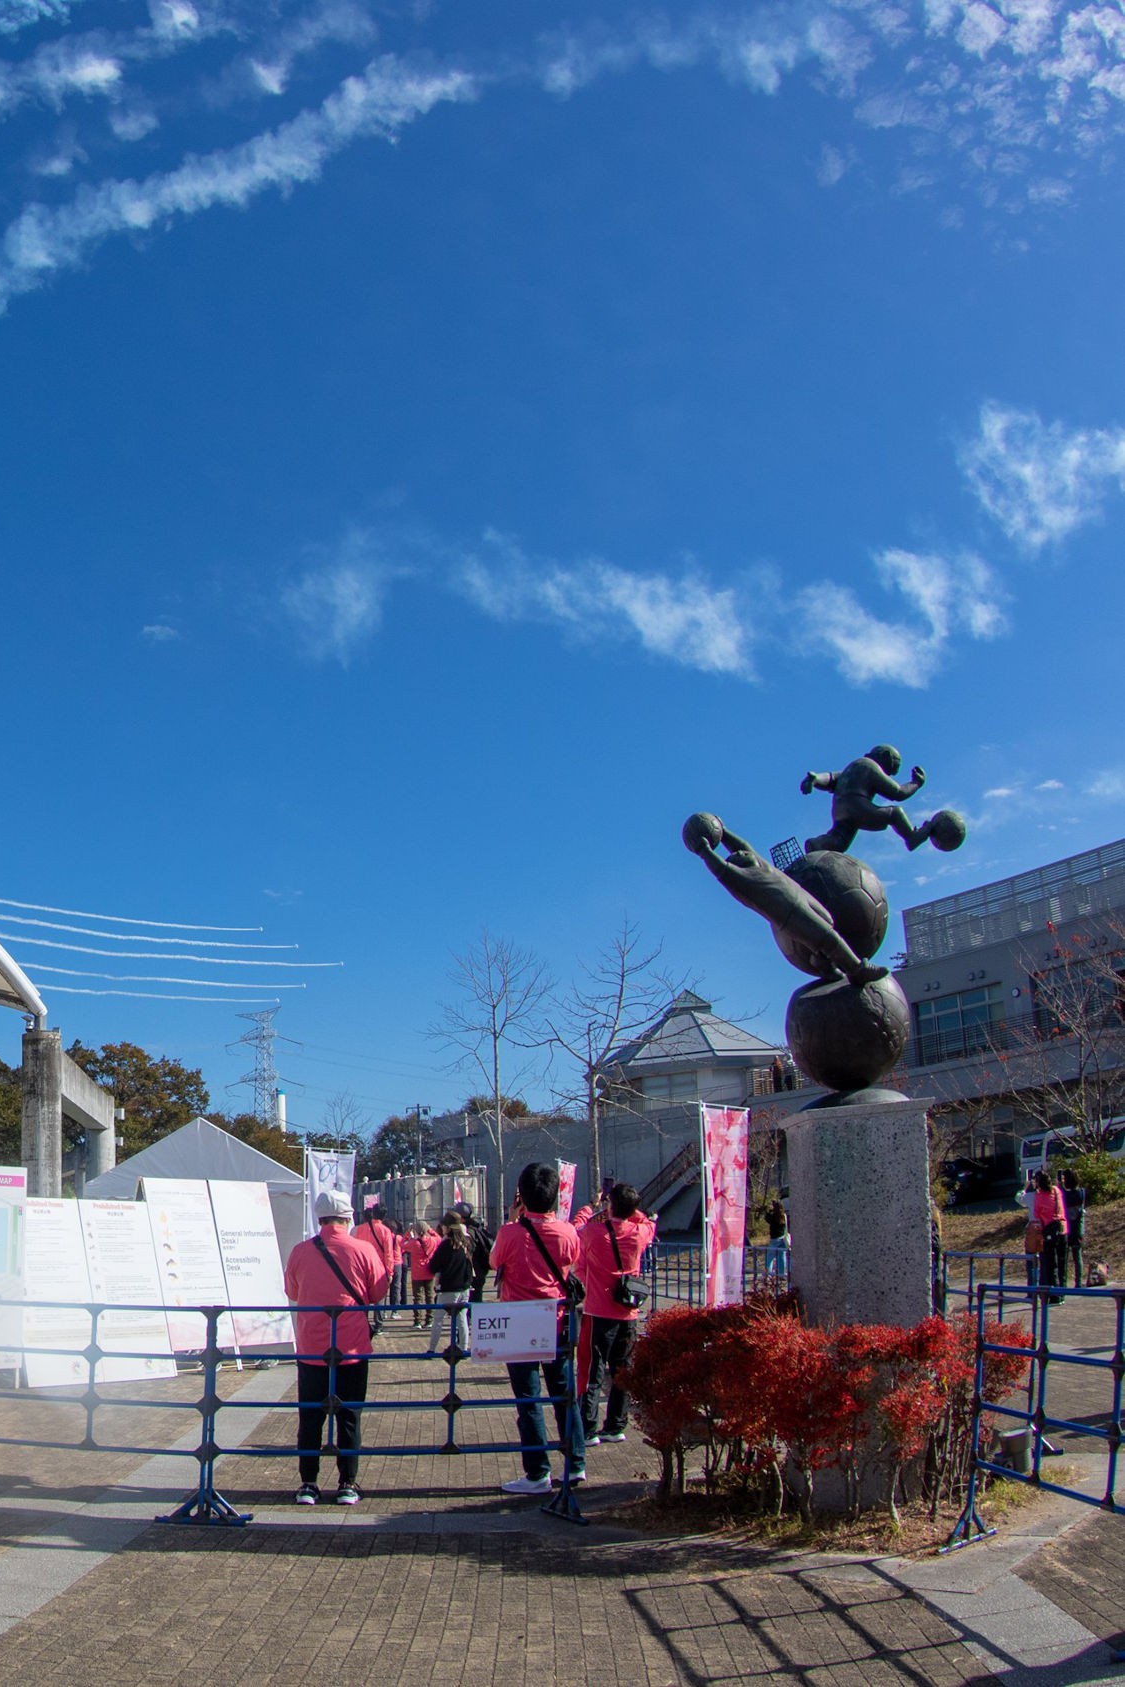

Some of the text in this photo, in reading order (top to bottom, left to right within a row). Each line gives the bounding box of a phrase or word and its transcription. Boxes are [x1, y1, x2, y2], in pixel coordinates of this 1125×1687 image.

[220, 1229, 275, 1238] General Information
[225, 1256, 261, 1265] Accessibility
[478, 1317, 511, 1330] EXIT
